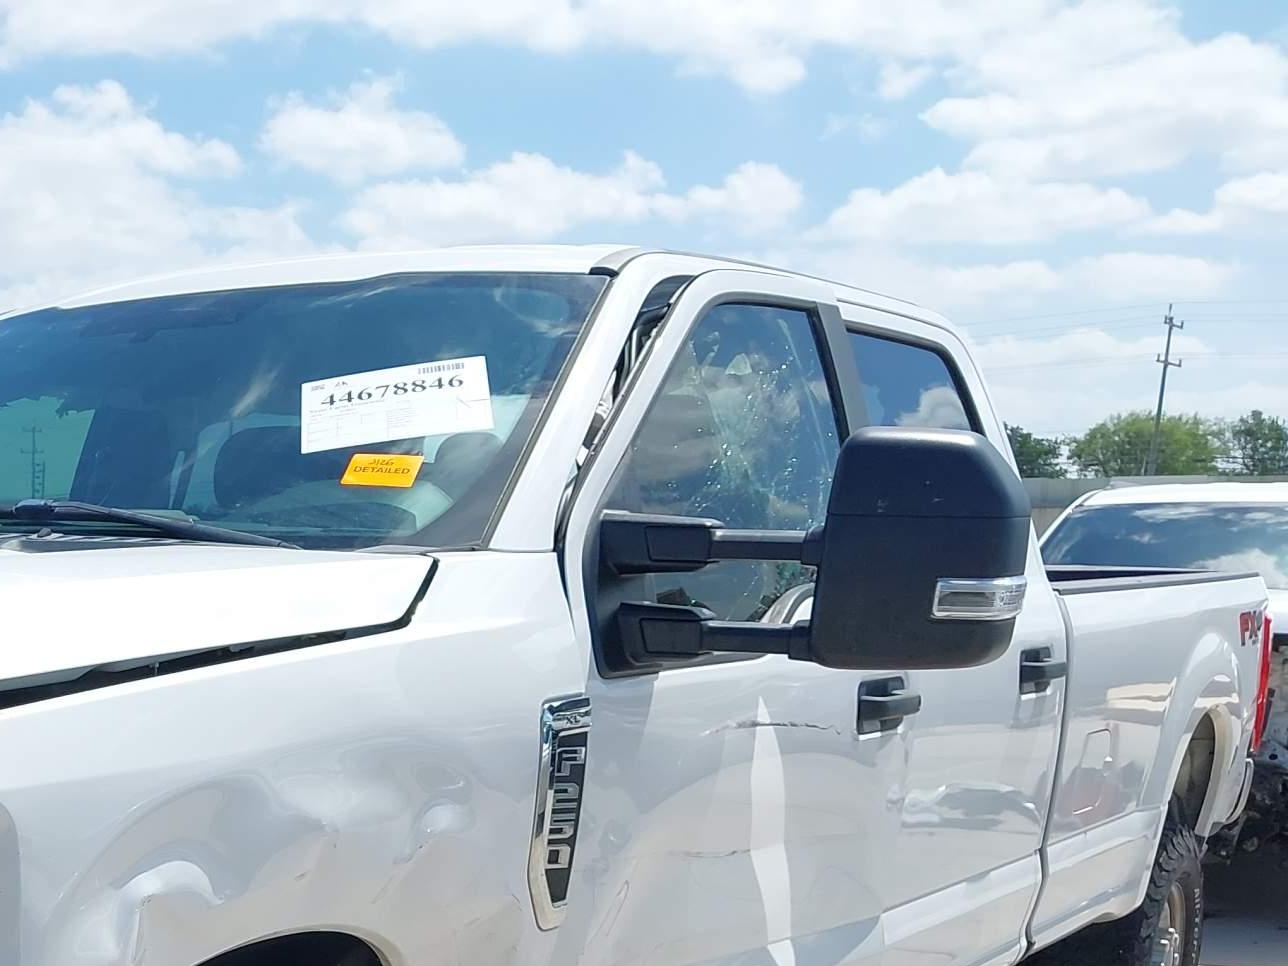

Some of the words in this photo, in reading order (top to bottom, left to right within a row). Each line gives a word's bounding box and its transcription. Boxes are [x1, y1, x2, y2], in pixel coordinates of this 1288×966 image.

[320, 374, 464, 406] 44678846
[353, 466, 411, 475] DETAILED
[565, 714, 581, 725] XL
